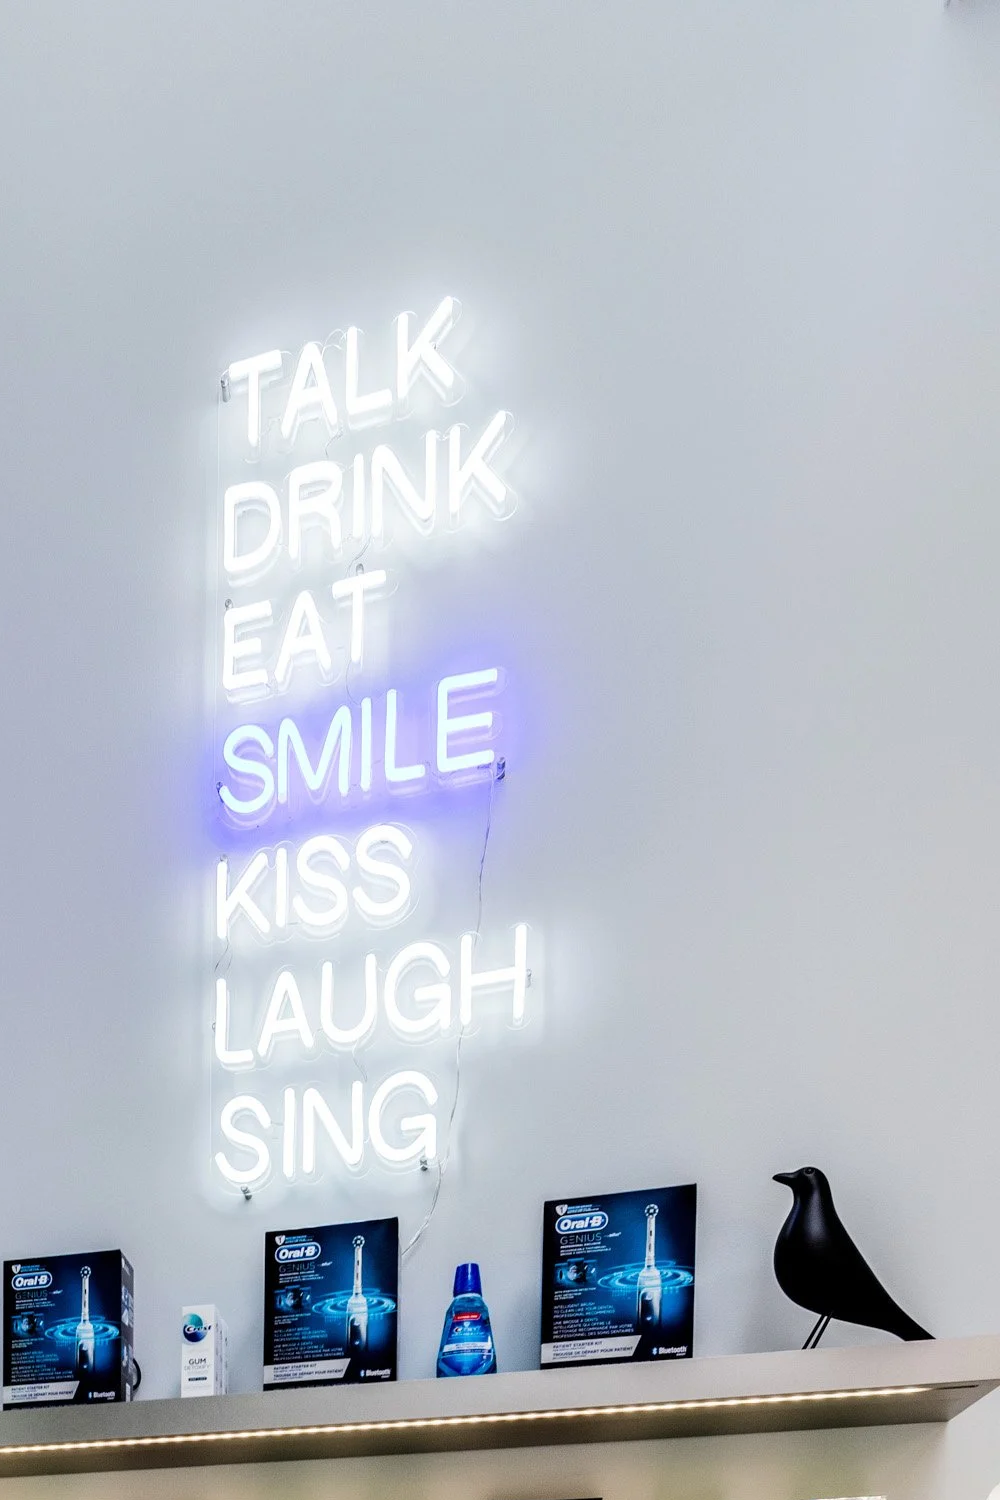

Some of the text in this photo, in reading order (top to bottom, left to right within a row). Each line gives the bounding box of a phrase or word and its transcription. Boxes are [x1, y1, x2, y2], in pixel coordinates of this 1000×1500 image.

[226, 296, 458, 450] TALK
[222, 410, 509, 575] DRINK
[221, 568, 389, 692] EAT
[218, 666, 499, 814] SMILE
[215, 823, 413, 939] KISS
[214, 923, 528, 1066] LAUGH
[214, 1070, 439, 1184] SING
[279, 1246, 316, 1259] Oral-B
[560, 1216, 603, 1230] Oral-B
[560, 1232, 602, 1245] GENIUS
[15, 1275, 48, 1287] Oral-B
[15, 1290, 48, 1300] GENIUS
[279, 1262, 316, 1273] GENIUS
[659, 1346, 687, 1355] Bluetooth
